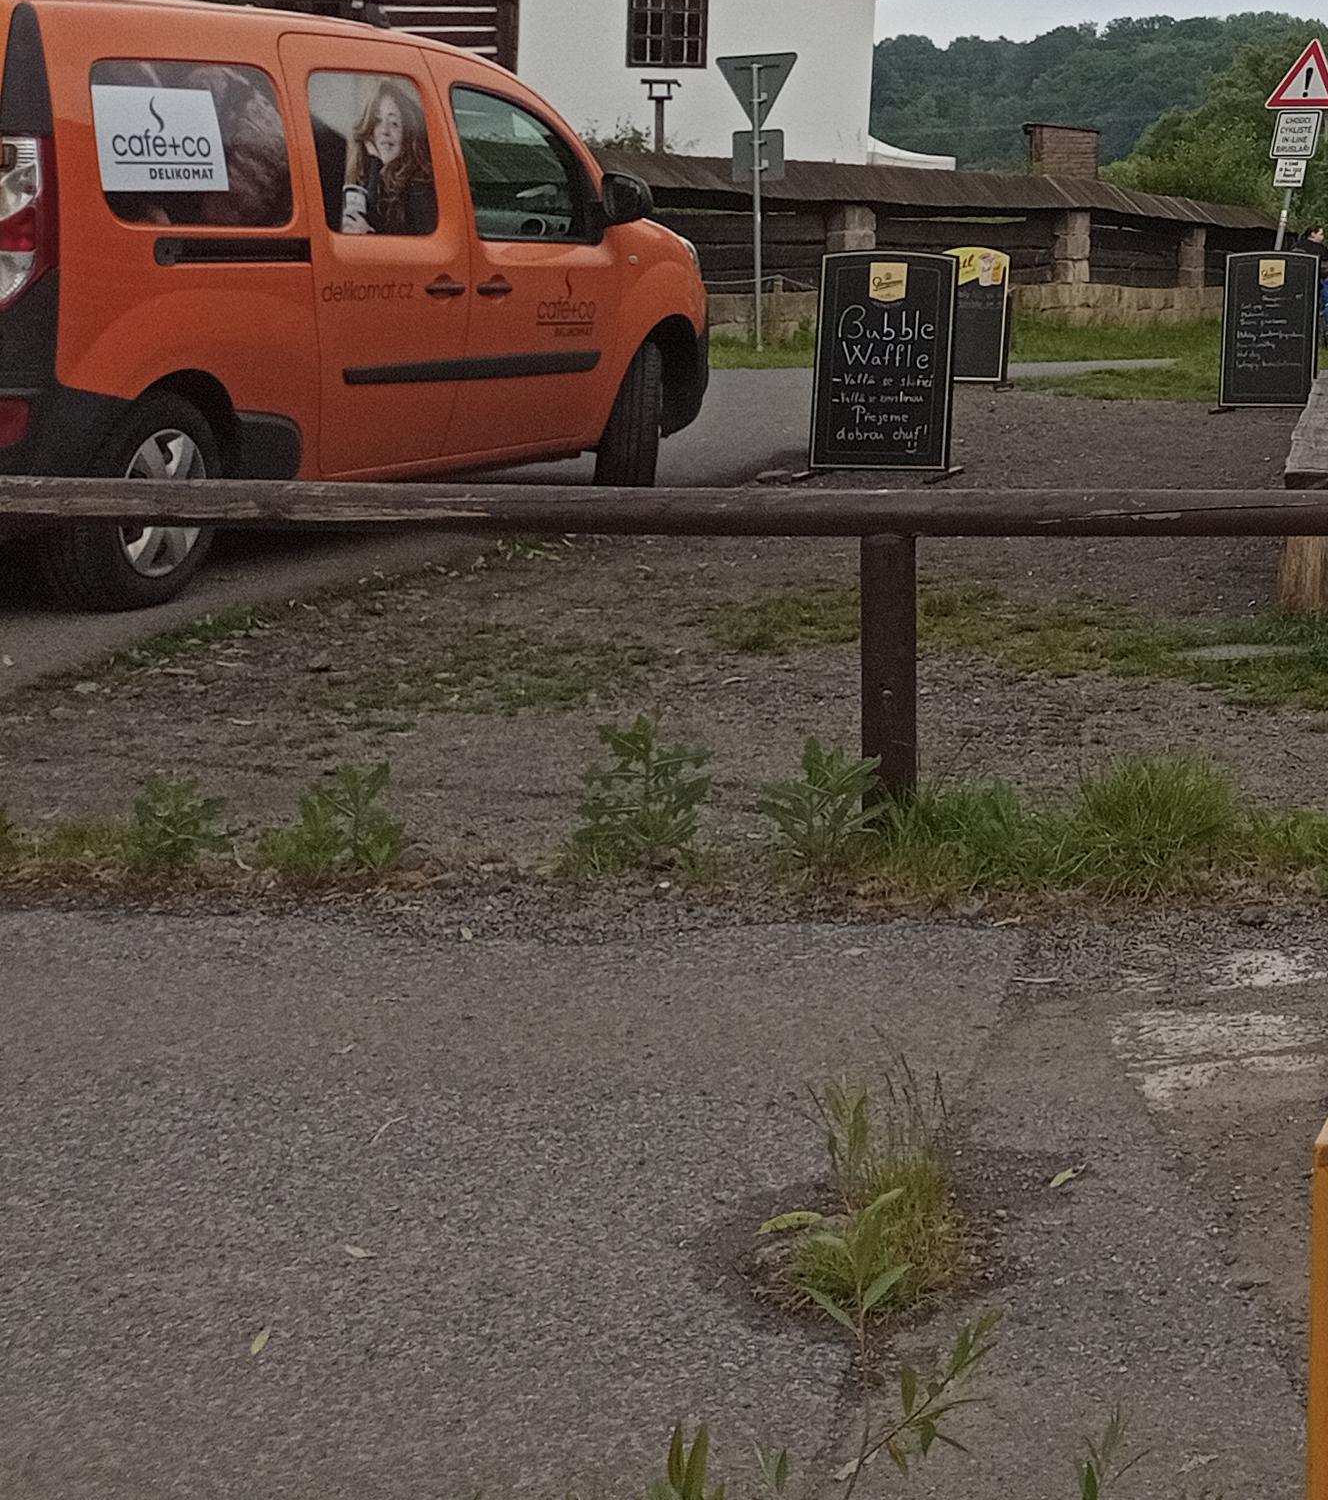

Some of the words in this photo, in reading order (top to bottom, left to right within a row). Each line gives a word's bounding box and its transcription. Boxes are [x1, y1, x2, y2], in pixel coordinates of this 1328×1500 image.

[149, 168, 213, 180] DELIKOMAT
[322, 281, 414, 302] delikomat.cz
[838, 304, 935, 341] Bubble
[842, 341, 929, 369] Waffle
[836, 427, 884, 441] dobrou
